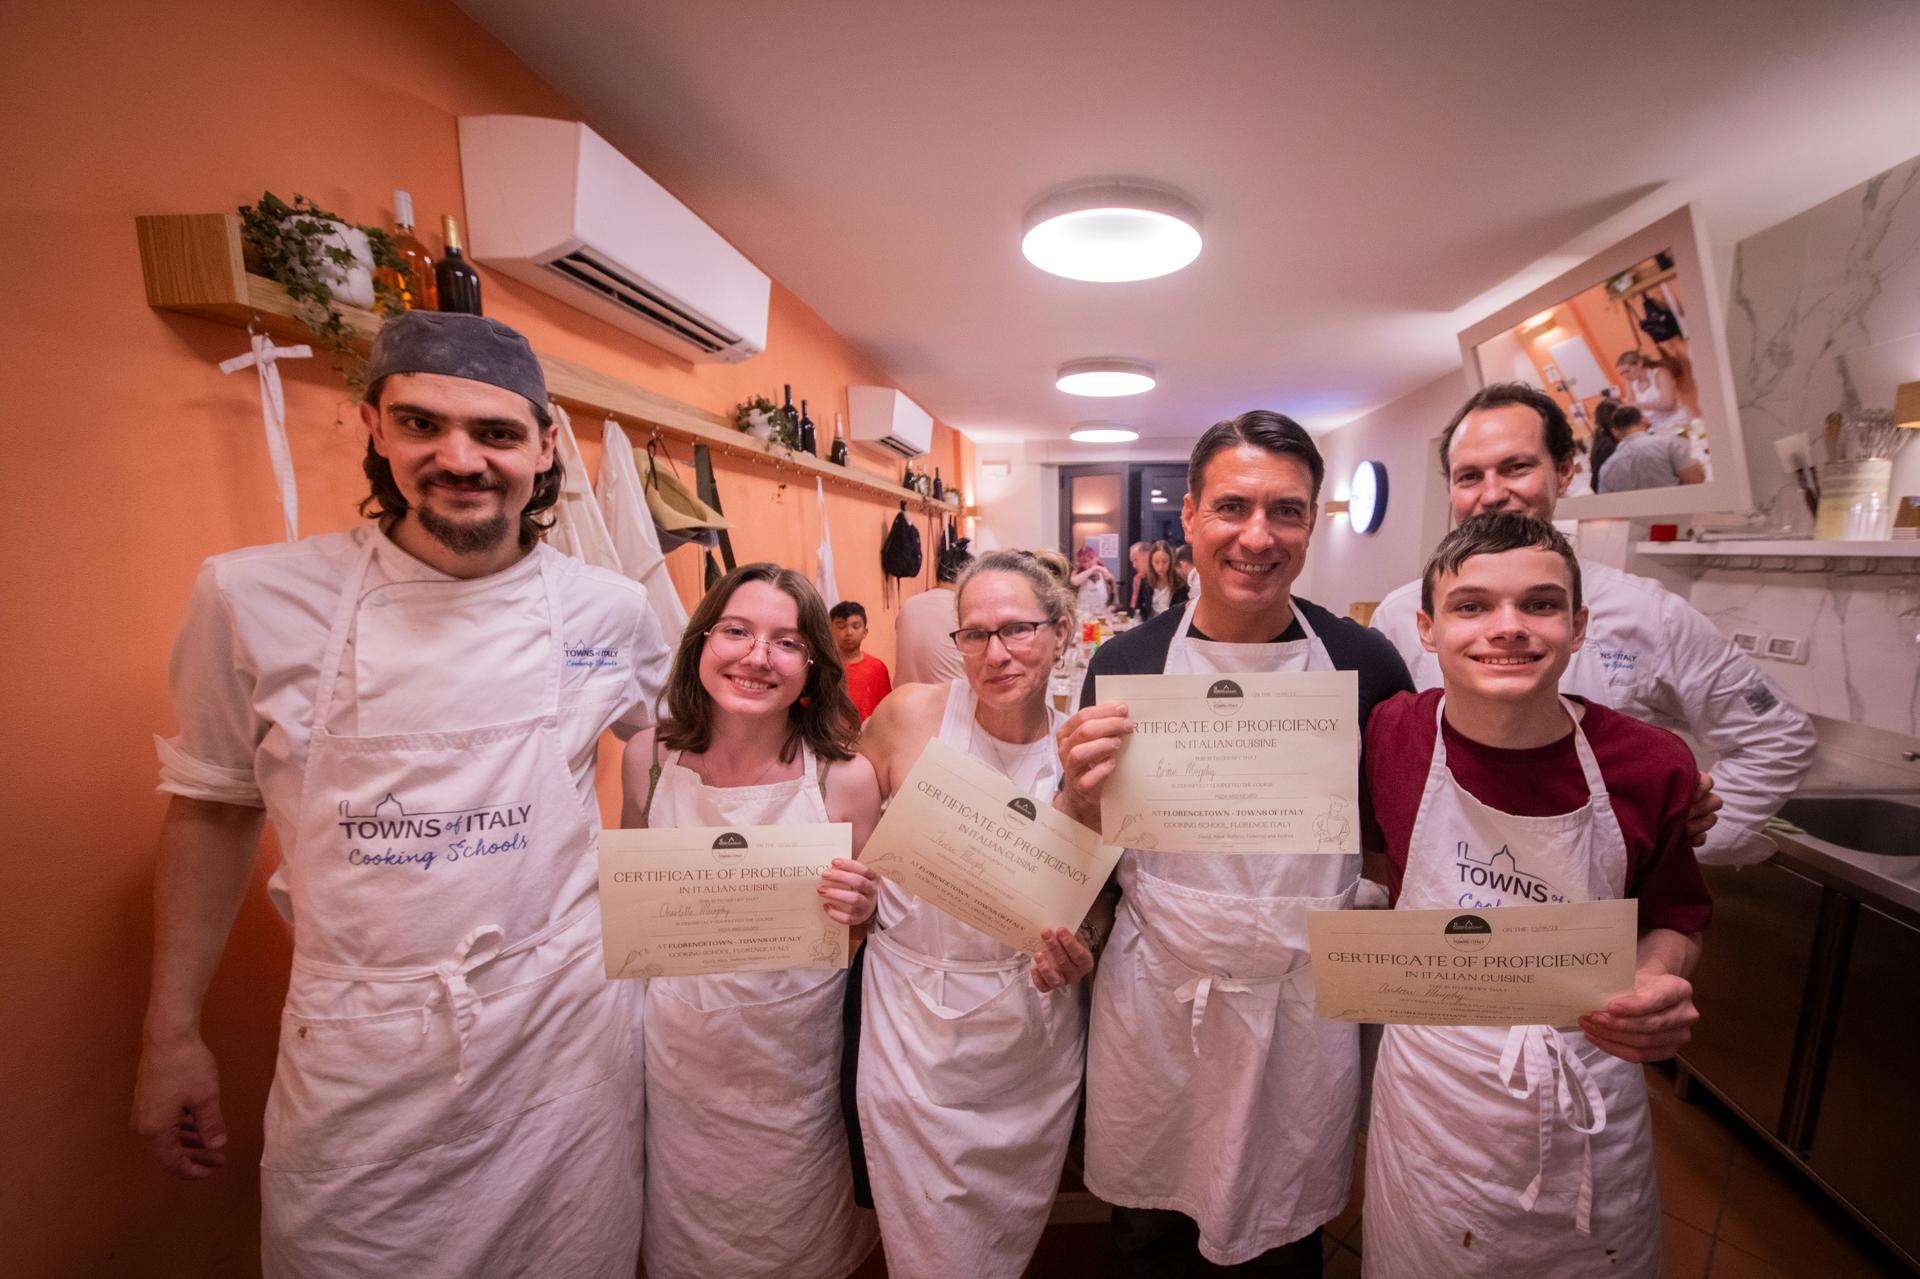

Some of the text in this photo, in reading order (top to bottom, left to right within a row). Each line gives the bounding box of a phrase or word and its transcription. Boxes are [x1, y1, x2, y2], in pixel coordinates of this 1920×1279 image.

[565, 649, 594, 657] TOWNS
[601, 649, 618, 657] ITALY
[1133, 718, 1340, 734] RTIFICATE OF PROFICIENCY
[1175, 738, 1278, 749] IN ITALIAN CUISINE
[1236, 809, 1268, 817] TOWNS
[1280, 808, 1305, 816] ITALY
[339, 804, 532, 840] TOWNS of ITALY
[917, 779, 994, 833] CERTIFICATE
[996, 826, 1016, 844] OF
[1013, 836, 1091, 887] PROFICIENCY
[348, 832, 530, 871] Cooking Schools
[958, 823, 969, 834] IN
[968, 828, 1005, 857] ITALIAN
[1004, 848, 1039, 875] CUISINE
[613, 869, 713, 883] CERTIFICATE
[717, 868, 738, 881] OF
[1456, 862, 1548, 904] TOWNS
[679, 883, 779, 895] IN ITALIAN CUISINE
[1328, 951, 1614, 969] CERTIFICATE OF PROFICIENCY
[1405, 970, 1536, 984] IN ITALIAN CUISINE
